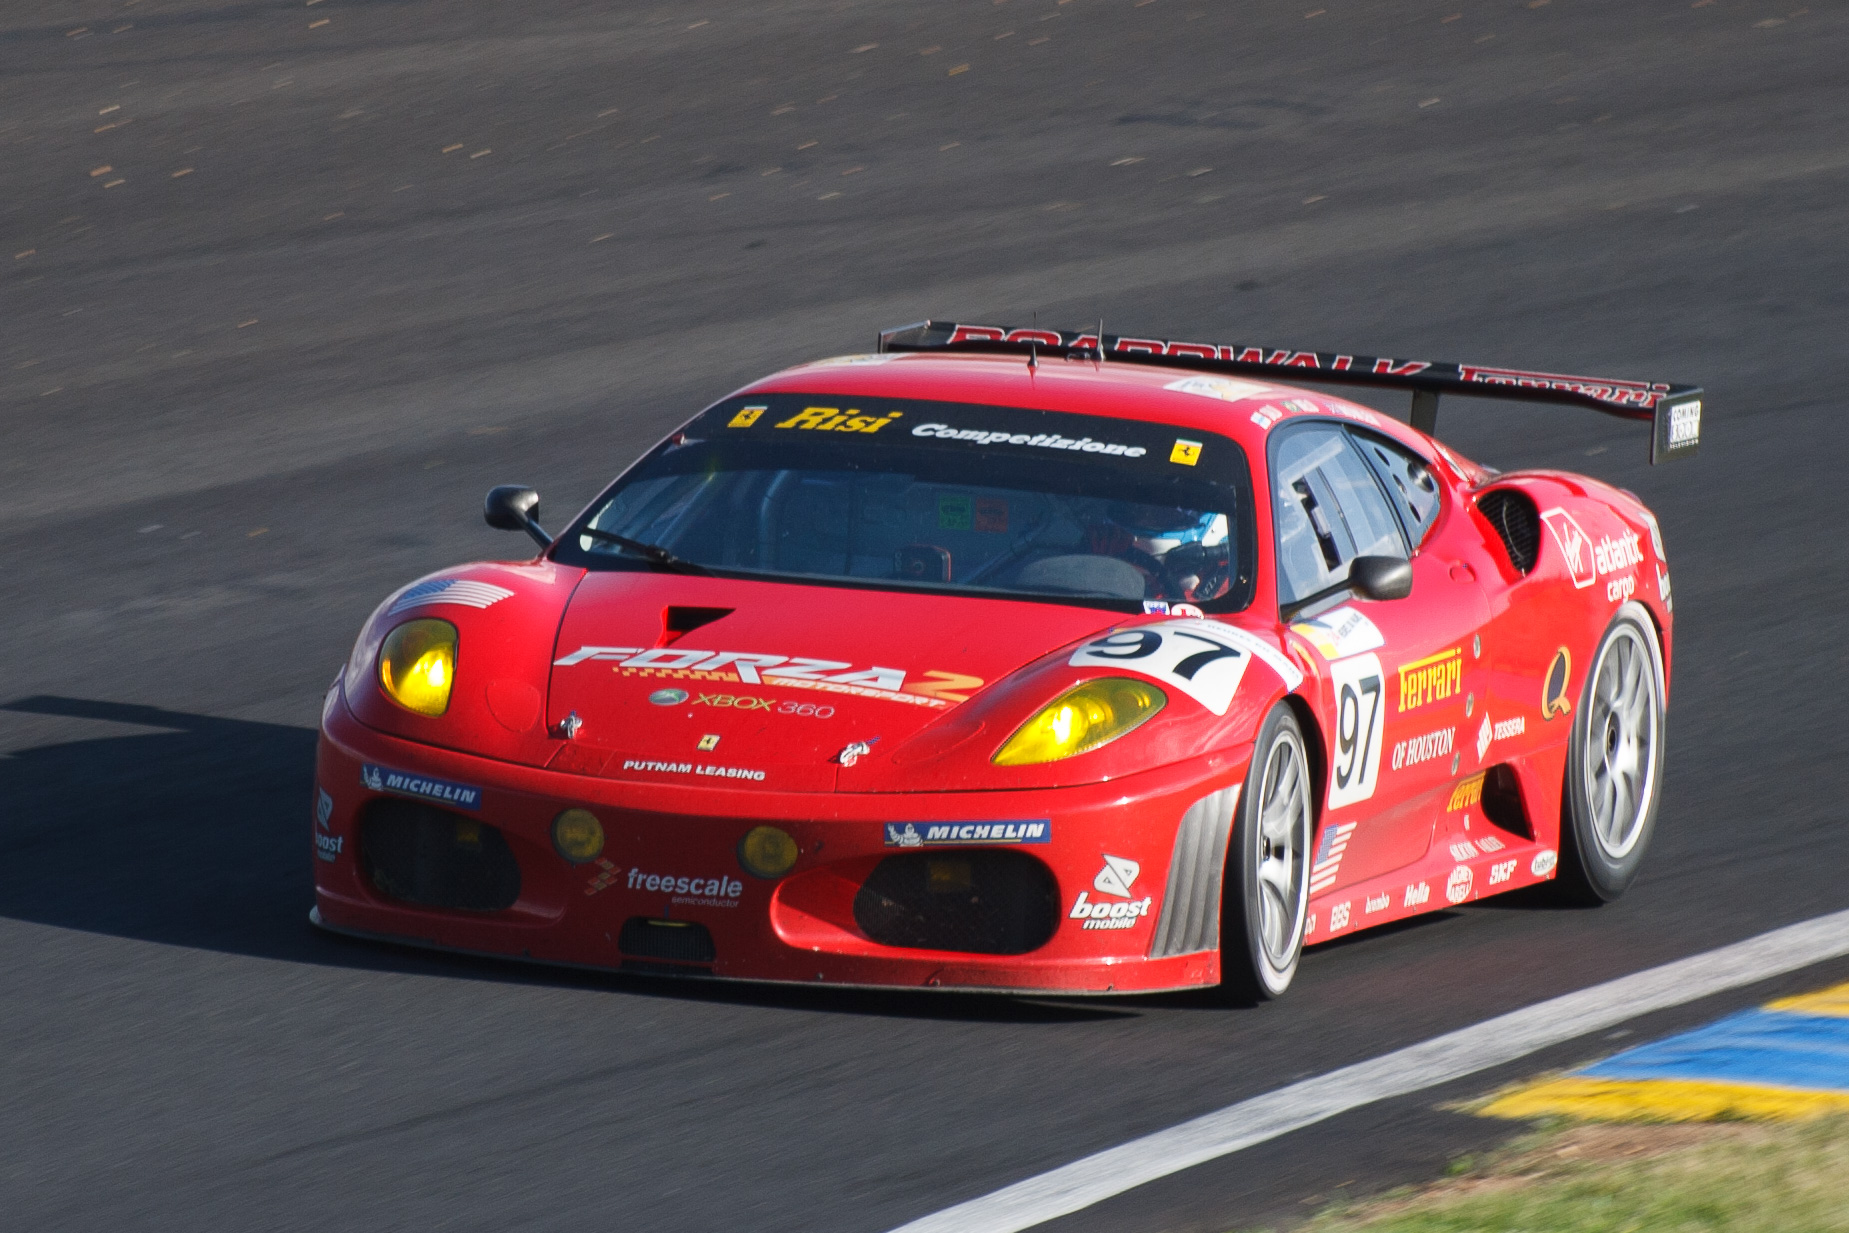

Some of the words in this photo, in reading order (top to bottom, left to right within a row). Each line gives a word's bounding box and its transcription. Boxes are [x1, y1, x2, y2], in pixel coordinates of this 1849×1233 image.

[774, 406, 903, 434] Risi
[911, 423, 1147, 457] Competizione
[1594, 528, 1644, 575] atlantic
[1607, 575, 1634, 604] cargo
[1086, 630, 1241, 681] 97
[553, 645, 907, 692] FORZA
[902, 669, 985, 703] 2
[1397, 647, 1462, 713] Ferrari
[691, 692, 776, 712] XBOX
[777, 700, 835, 719] 360
[770, 676, 947, 708] MOTORSPORT
[1336, 673, 1382, 790] 97
[1493, 716, 1526, 741] TESSERA
[1391, 741, 1407, 771] OF
[1405, 726, 1456, 767] HOUSTON
[623, 760, 692, 774] PUTNAM
[696, 764, 766, 781] LEASING
[386, 773, 477, 804] MICHELIN
[926, 823, 1045, 840] MICHELIN
[627, 867, 743, 898] freescale
[1489, 859, 1517, 886] SKF
[671, 896, 739, 908] semiconductor
[1069, 891, 1152, 919] boost
[1403, 880, 1430, 908] Hella
[1081, 917, 1137, 930] mobile
[1330, 901, 1351, 932] BBS
